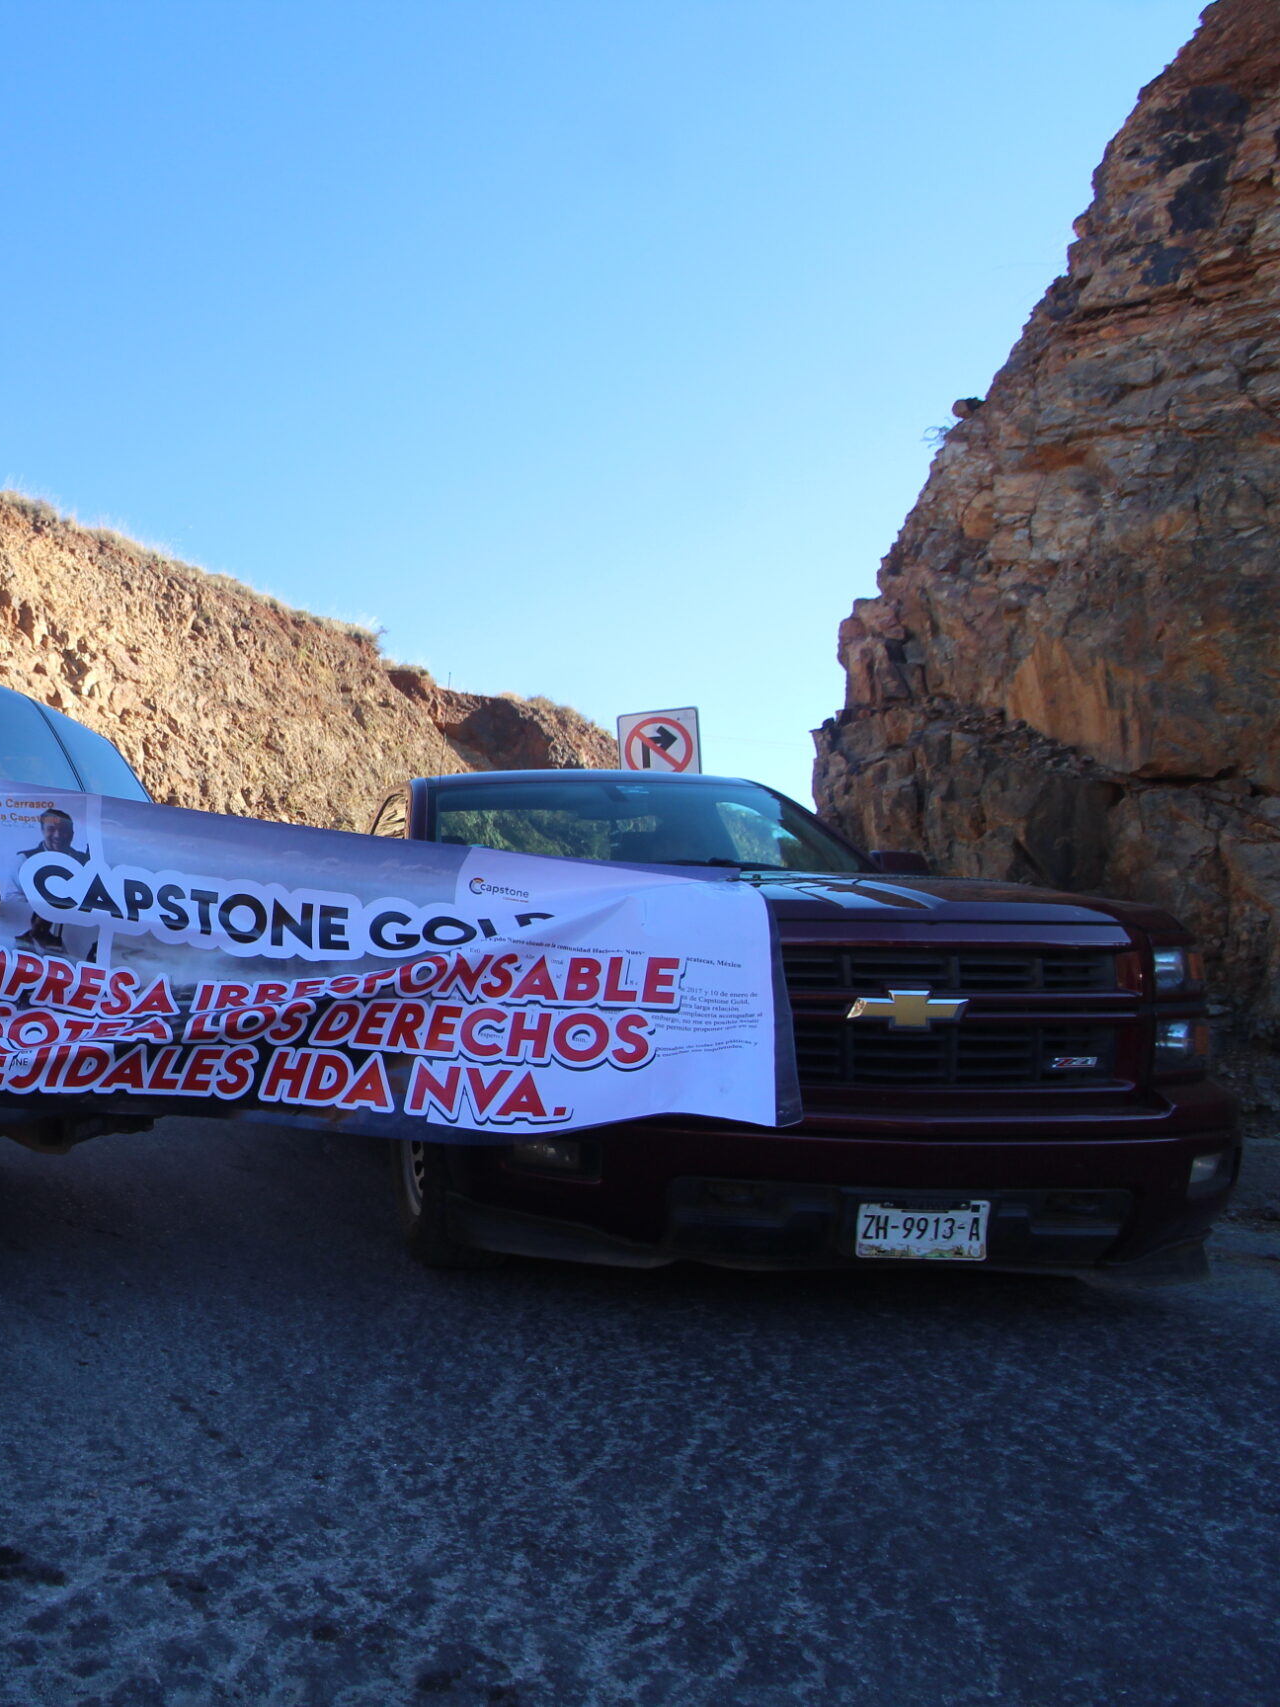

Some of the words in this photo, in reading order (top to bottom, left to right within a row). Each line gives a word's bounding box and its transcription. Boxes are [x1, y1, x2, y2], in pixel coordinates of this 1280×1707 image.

[6, 799, 55, 809] Carrasco
[33, 864, 349, 951] CAPSTONE
[556, 944, 590, 953] comunidad
[686, 956, 715, 965] acatecas,
[717, 959, 742, 968] México
[193, 951, 683, 1012] IRRESPONSABLE
[698, 997, 729, 1005] Capstone
[186, 999, 311, 1043] LOS
[317, 1001, 652, 1066] DERECHOS
[262, 1049, 390, 1108] HDA
[408, 1065, 569, 1119] NVA.
[862, 1215, 980, 1241] ZH-9913-A
